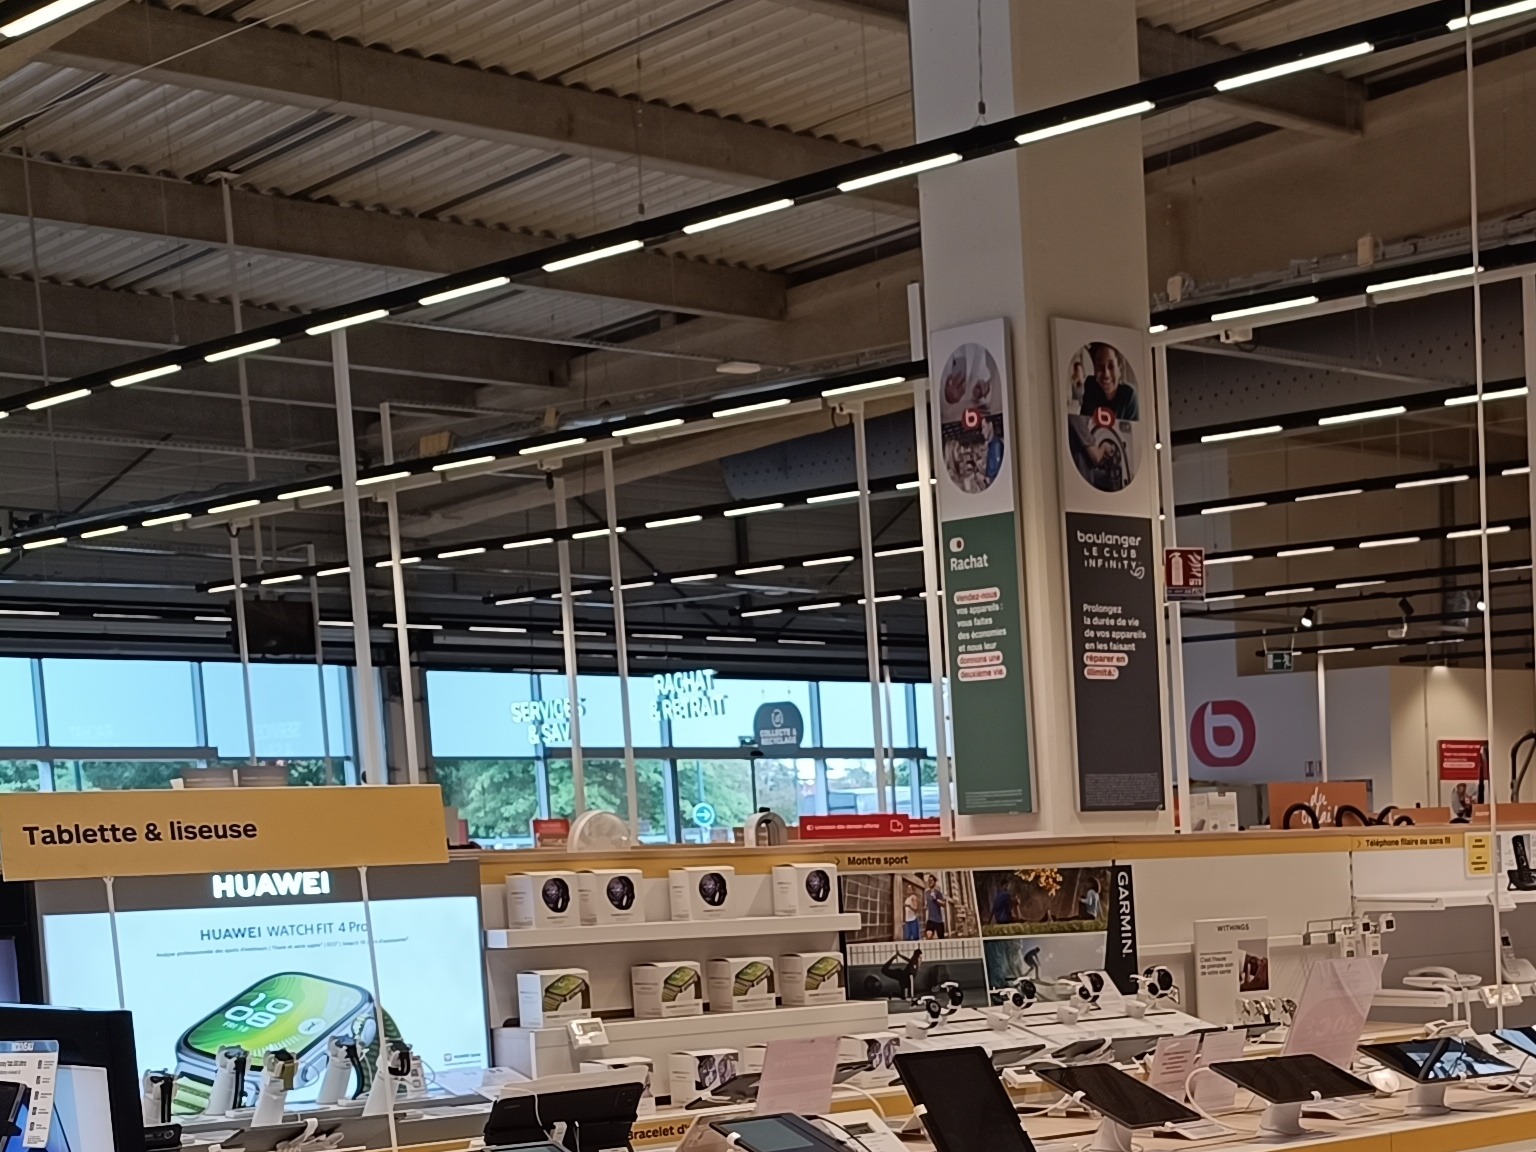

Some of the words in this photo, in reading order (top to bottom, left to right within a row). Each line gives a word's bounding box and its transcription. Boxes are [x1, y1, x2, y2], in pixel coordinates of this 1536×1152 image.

[1077, 530, 1141, 547] boulanger
[1104, 548, 1137, 558] CLUB
[950, 554, 989, 571] Rachat
[1085, 559, 1136, 569] INFINITY
[1083, 603, 1122, 615] Prolongez
[1083, 616, 1091, 625] la
[1092, 616, 1115, 626] durée
[1116, 617, 1126, 626] de
[1128, 617, 1140, 627] vie
[1084, 629, 1095, 638] de
[1096, 630, 1110, 638] vos
[1111, 629, 1147, 639] appareils
[1109, 641, 1136, 651] faisant
[652, 669, 717, 697] RACHAT
[22, 823, 137, 845] Tablette
[145, 822, 163, 842] &
[170, 820, 258, 841] liseuse
[1366, 839, 1399, 848] Téléphone
[847, 856, 881, 866] Montre
[883, 855, 908, 866] sport
[212, 871, 330, 898] HUAWEI
[1117, 871, 1133, 954] GARMIN
[201, 926, 262, 941] HUAWEI
[267, 923, 314, 938] WATCH
[317, 923, 333, 935] FIT
[339, 922, 346, 932] 4
[349, 921, 369, 932] Pro
[224, 1005, 277, 1029] 08
[628, 1125, 674, 1140] Bracelet
